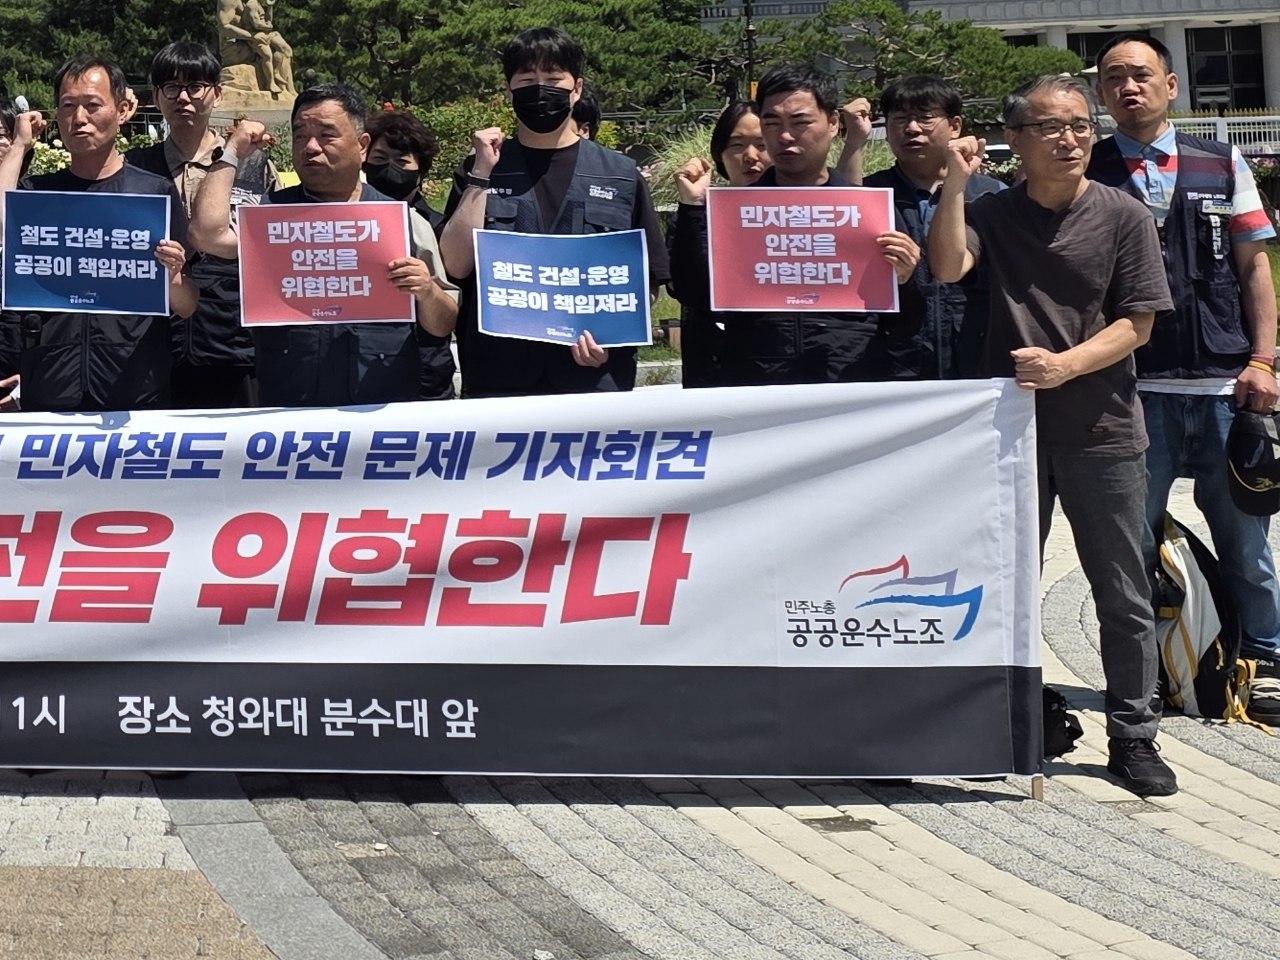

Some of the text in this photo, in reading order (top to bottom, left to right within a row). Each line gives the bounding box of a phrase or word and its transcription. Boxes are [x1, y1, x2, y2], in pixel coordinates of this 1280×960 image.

[740, 206, 861, 228] 민자철도가
[20, 224, 59, 246] 철도
[267, 220, 380, 244] 민자철도가
[765, 234, 836, 257] 안전을
[14, 254, 158, 280] 공공이 책임져라
[292, 248, 358, 271] 안전을
[492, 261, 533, 283] 철도
[754, 262, 851, 285] 위협한다
[281, 276, 372, 298] 위협한다
[488, 286, 638, 314] 공공이 책임져라
[16, 432, 227, 480] 민자철도
[241, 430, 352, 480] 안전
[363, 430, 475, 480] 문제
[486, 429, 714, 481] 기자회견
[196, 509, 693, 628] 위협한다
[784, 600, 836, 614] 민주노총
[786, 618, 945, 648] 공공운수노조
[118, 696, 192, 734] 장소
[201, 696, 308, 738] 청와대
[320, 698, 430, 738] 분수대
[441, 698, 479, 739] 앞
